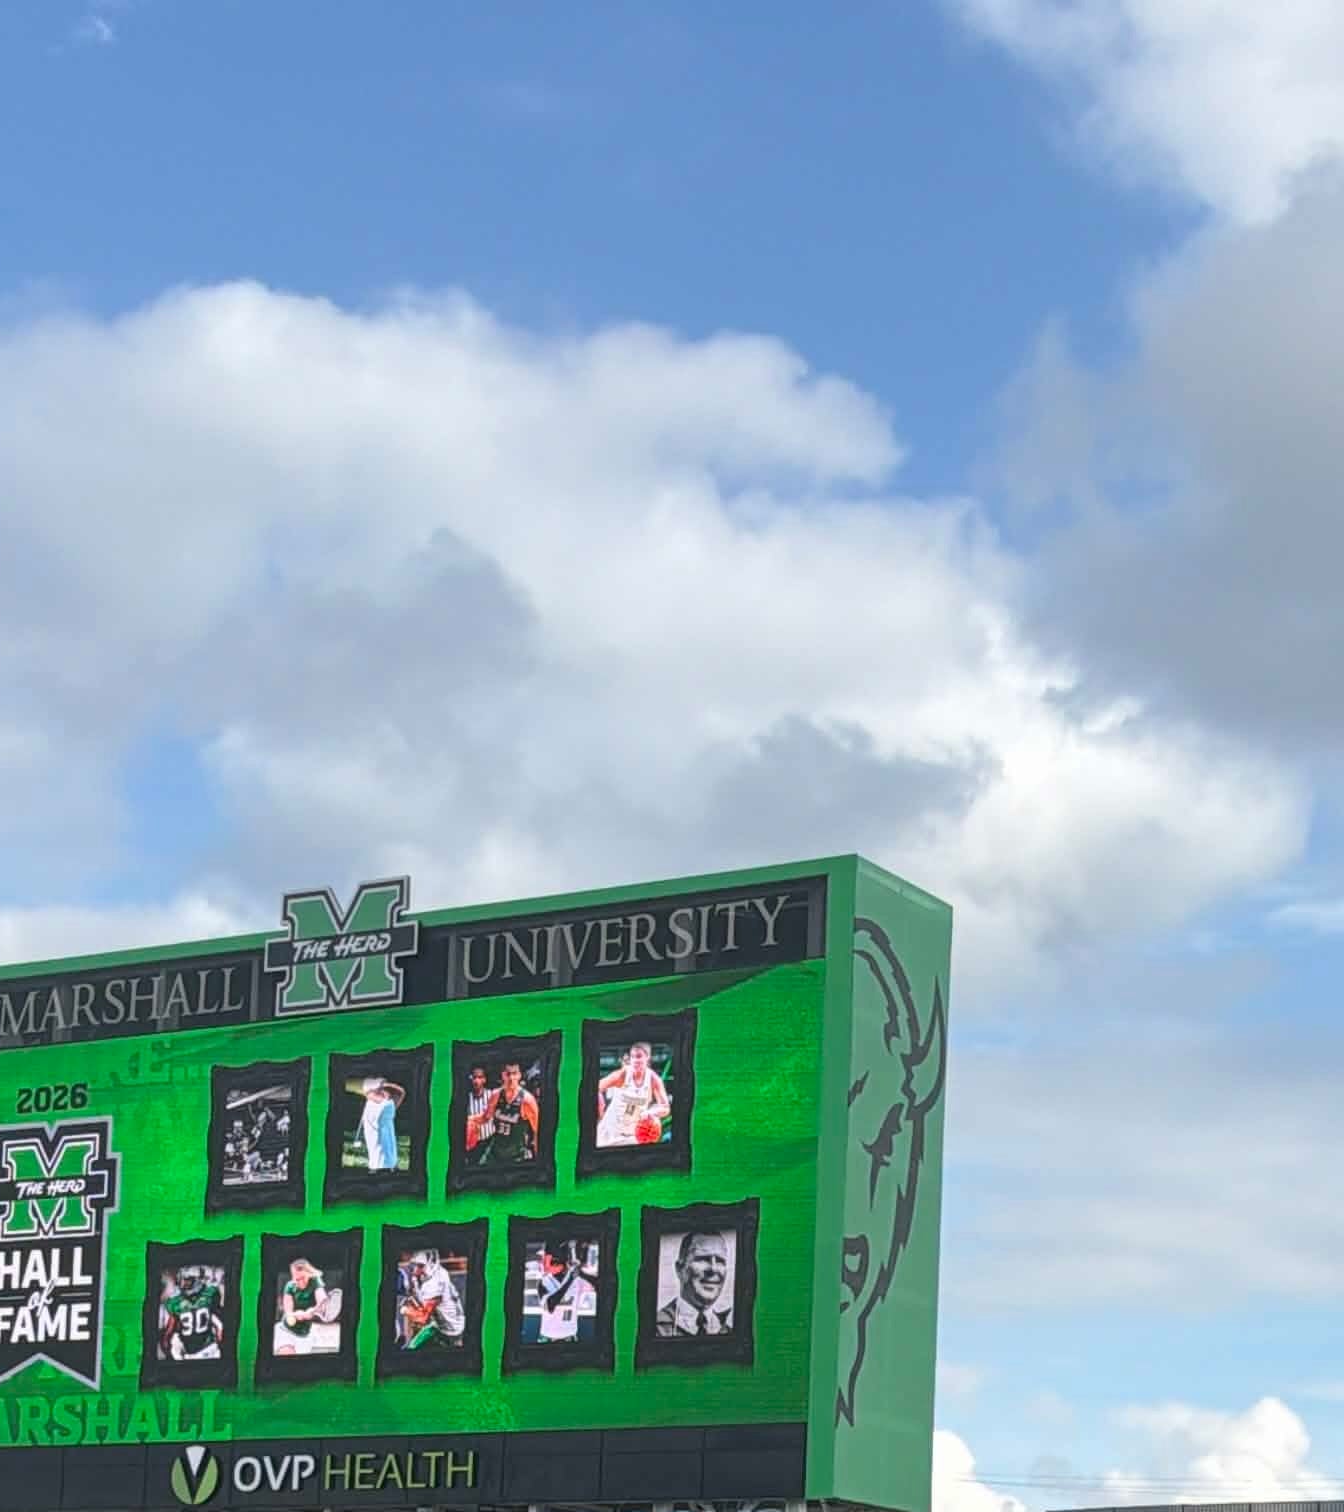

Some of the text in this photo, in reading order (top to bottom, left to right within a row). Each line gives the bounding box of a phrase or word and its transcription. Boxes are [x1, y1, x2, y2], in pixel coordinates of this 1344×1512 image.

[292, 932, 391, 962] THE HERD
[461, 897, 791, 983] UNIVERSITY
[16, 1083, 89, 1115] 2026
[16, 1178, 86, 1199] THE HERD
[26, 1280, 55, 1316] of
[180, 1308, 210, 1336] 30
[233, 1451, 475, 1491] OVP HEALTH
